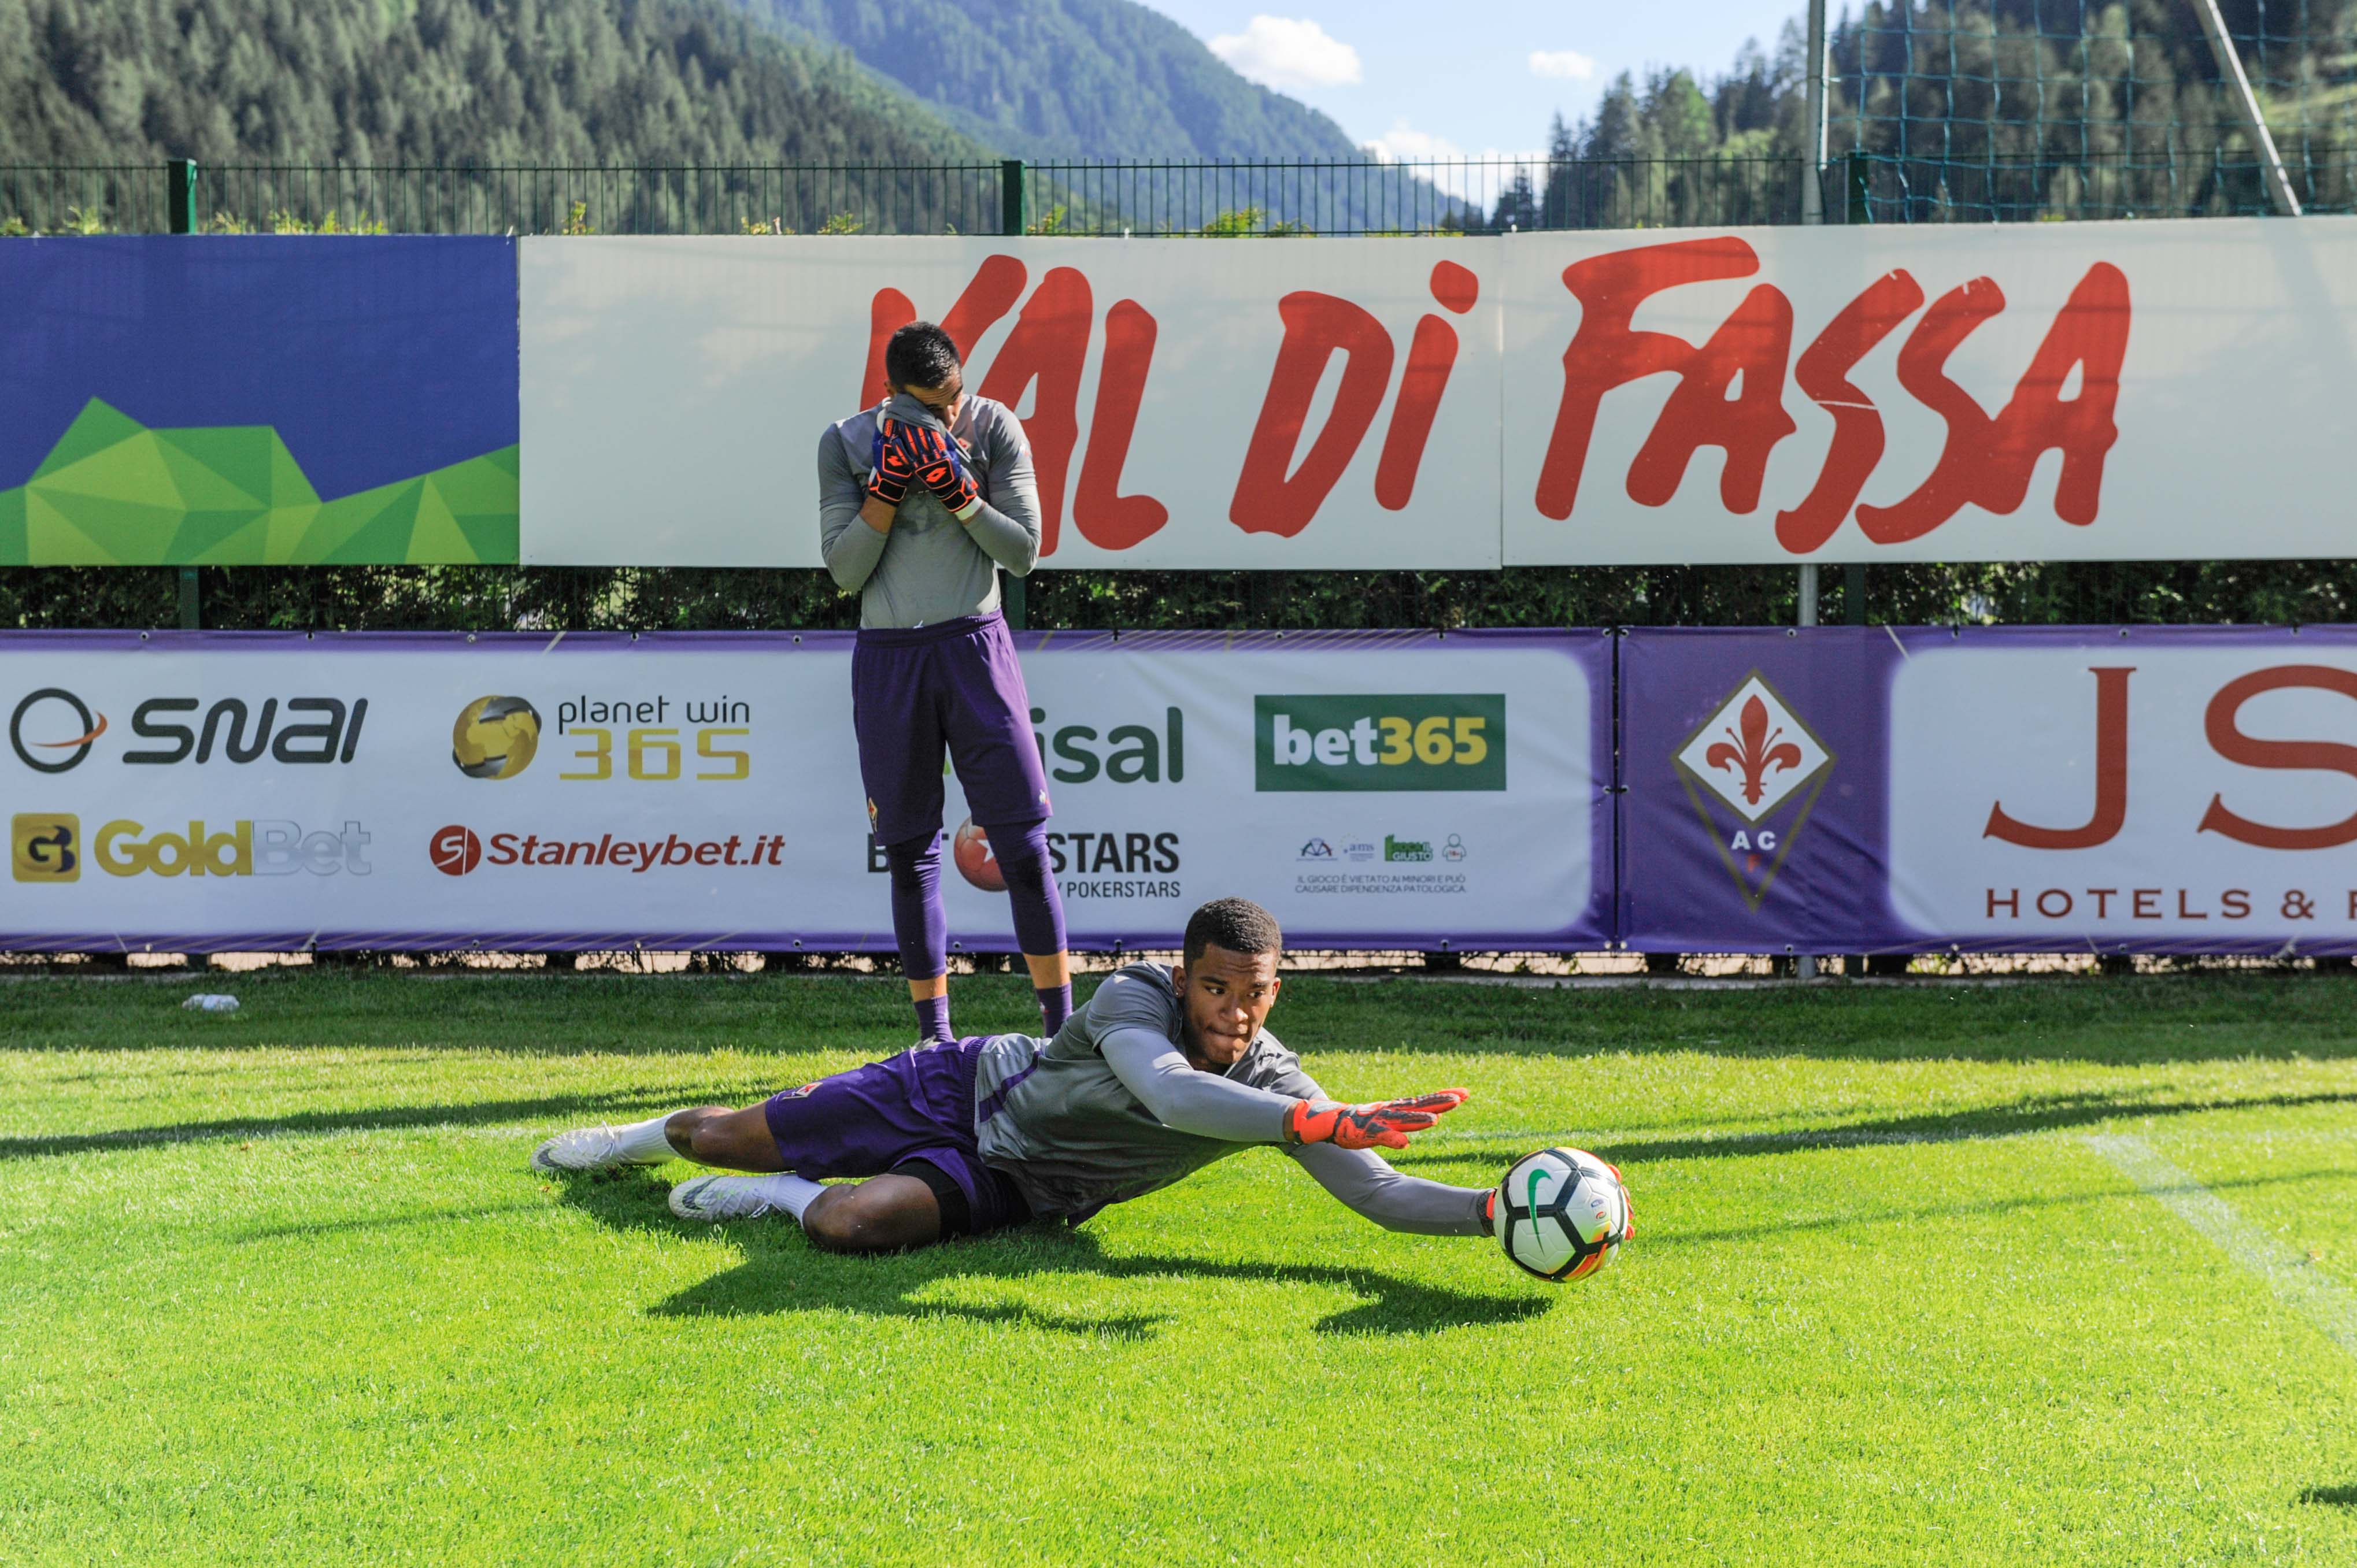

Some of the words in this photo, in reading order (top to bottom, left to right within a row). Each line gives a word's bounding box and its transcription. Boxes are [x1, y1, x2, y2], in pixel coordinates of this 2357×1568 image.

[1535, 236, 2131, 554] FASSA
[558, 695, 670, 735] planet
[686, 695, 750, 723] win
[558, 729, 750, 781] 365
[1274, 714, 1487, 766] bet365
[94, 819, 372, 877] GoldBet
[487, 833, 785, 873] Stanleybet.it
[1392, 851, 1433, 861] GIUSTO
[1067, 881, 1181, 898] POKERSTARS
[1294, 884, 1339, 894] CAUSARE
[1341, 884, 1402, 894] DIPENDENZA
[1307, 874, 1340, 884] GIOCO
[1349, 874, 1390, 884] VIETATO
[1986, 889, 2251, 919] HOTELS
[2280, 889, 2315, 920] &
